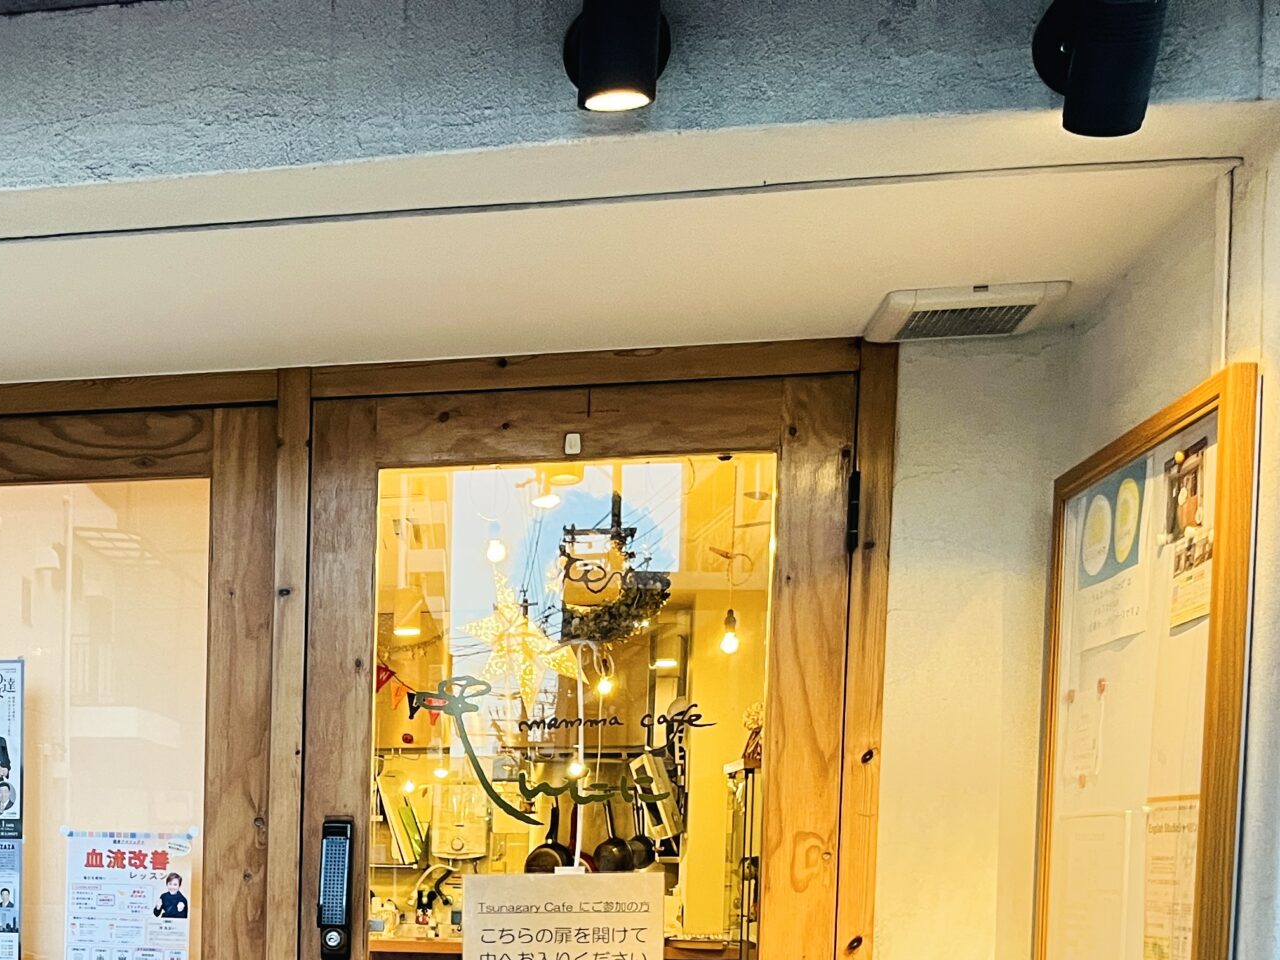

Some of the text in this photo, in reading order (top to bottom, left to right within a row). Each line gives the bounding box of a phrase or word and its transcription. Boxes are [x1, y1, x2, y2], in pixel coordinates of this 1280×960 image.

[518, 703, 717, 752] mamma cafe
[84, 848, 169, 871] 血流改善
[129, 871, 167, 880] レッスン
[478, 901, 650, 914] Tsunagary Cafe にご参加の方
[479, 926, 649, 944] こちらの扉を開けて
